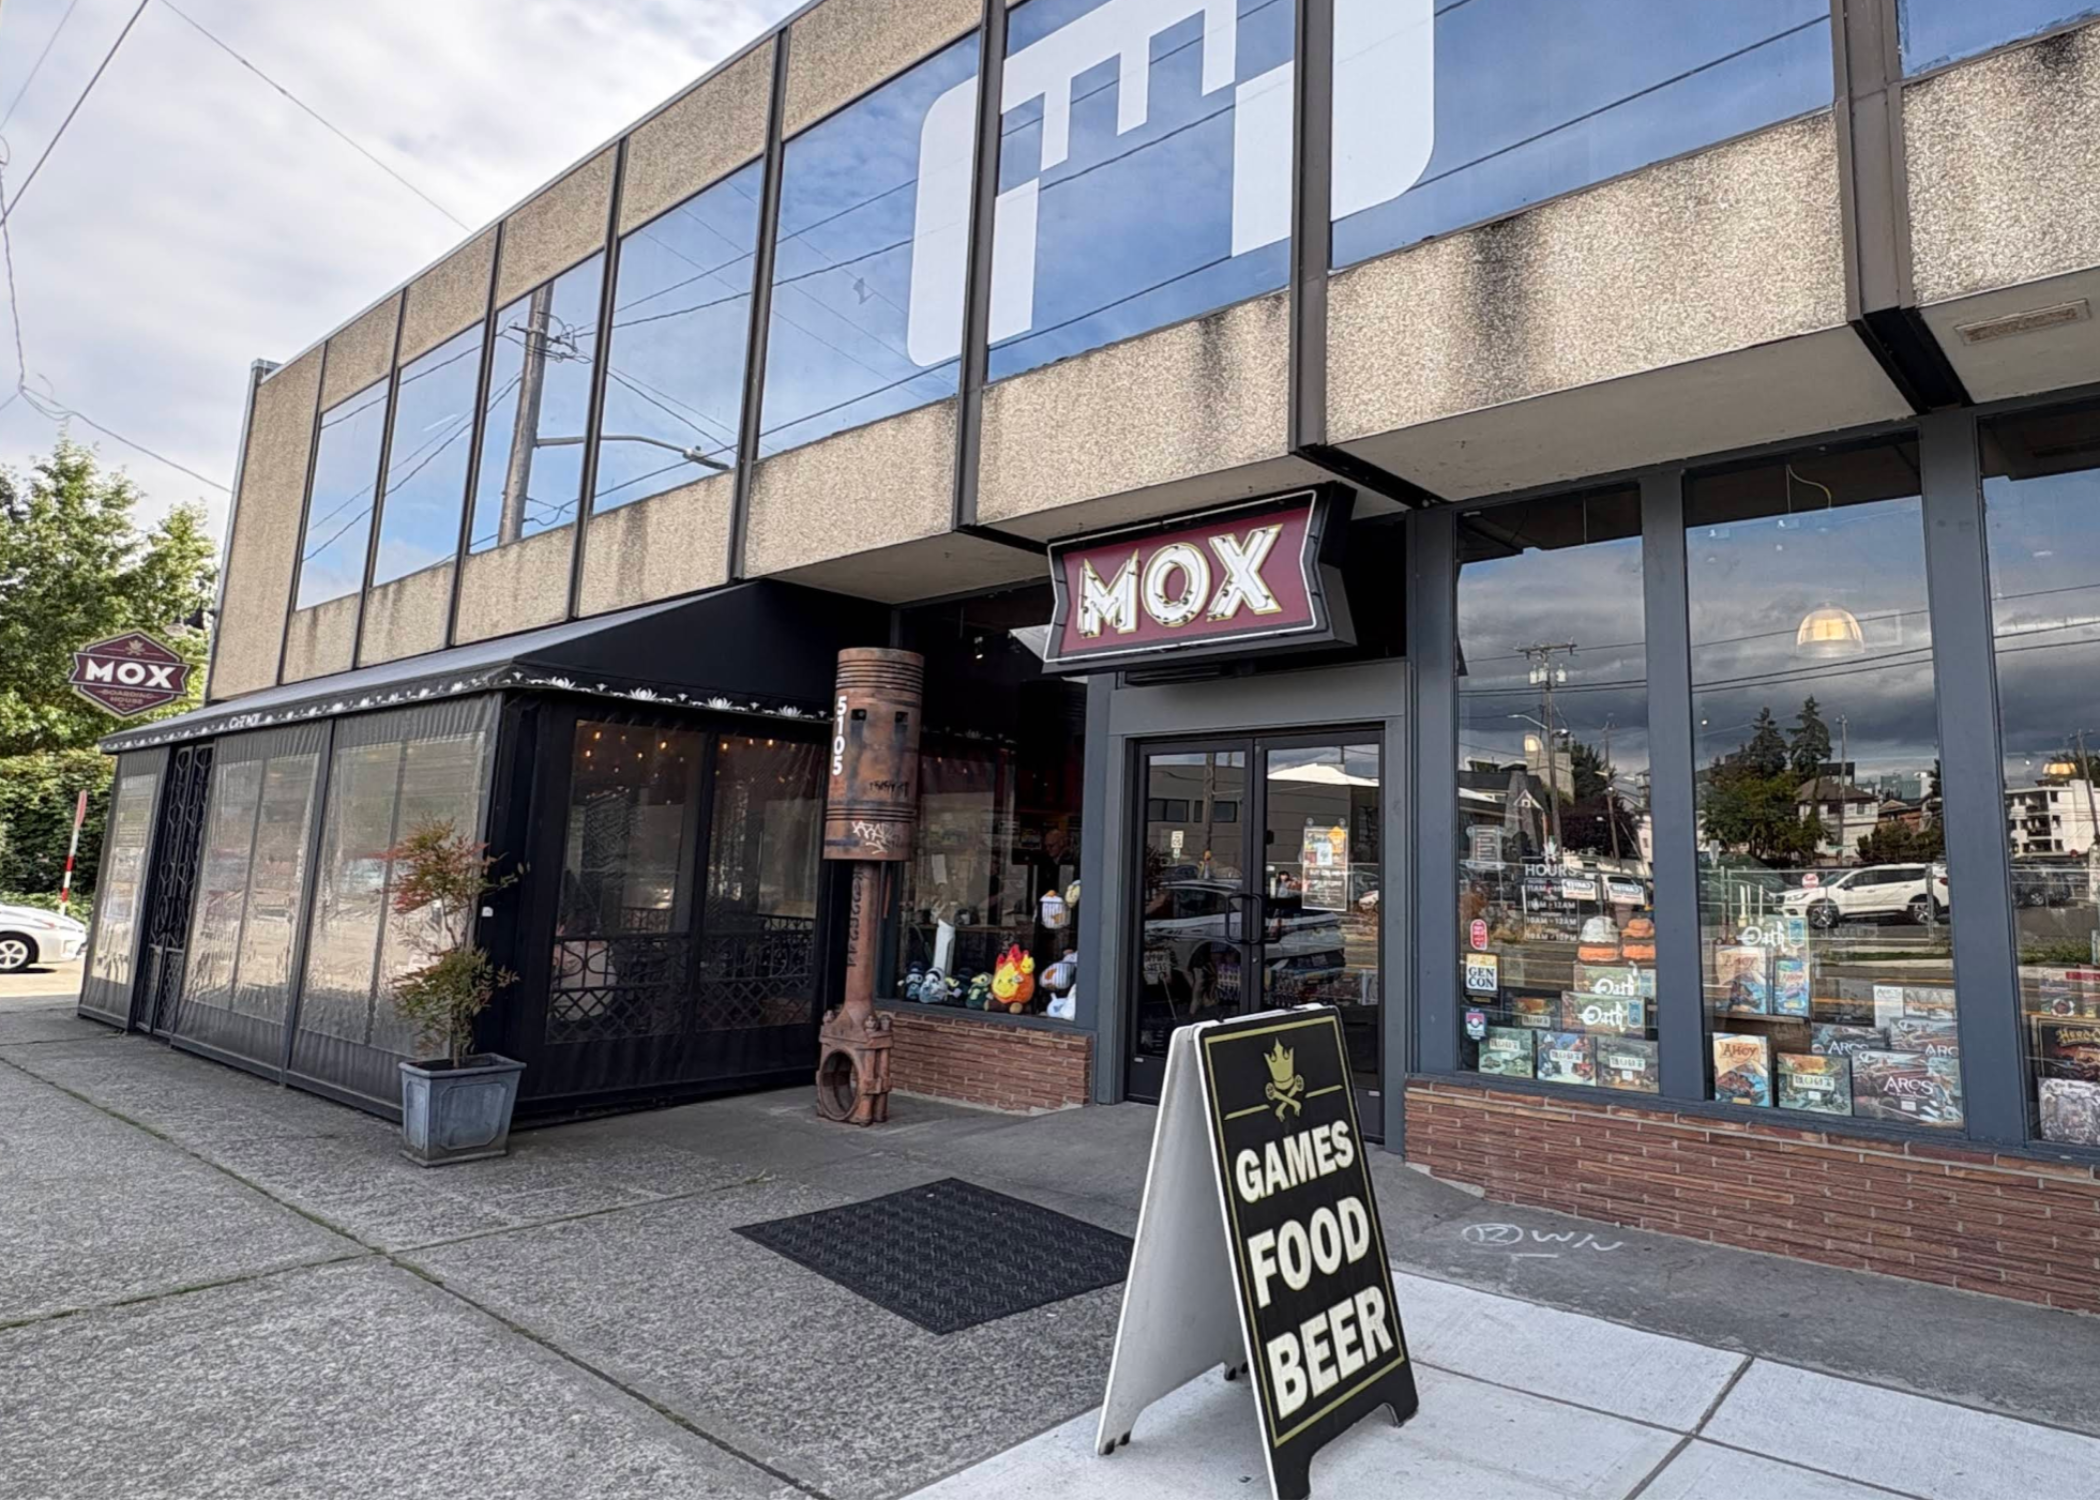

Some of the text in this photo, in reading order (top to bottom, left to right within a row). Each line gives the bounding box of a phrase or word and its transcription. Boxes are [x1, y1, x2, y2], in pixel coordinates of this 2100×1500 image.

[1077, 523, 1284, 639] MOX
[85, 658, 177, 689] MOX
[101, 689, 155, 699] BOARDING
[110, 696, 143, 705] HOUSE
[832, 696, 847, 775] 5105
[1525, 864, 1577, 877] HOURS
[1468, 967, 1495, 978] GEN
[1468, 977, 1494, 989] CON
[1720, 1043, 1758, 1058] AHOY
[1884, 1076, 1935, 1095] ARCS
[1235, 1120, 1354, 1203] GAMES
[1248, 1196, 1370, 1309] FOOD
[1266, 1285, 1394, 1420] BEER
